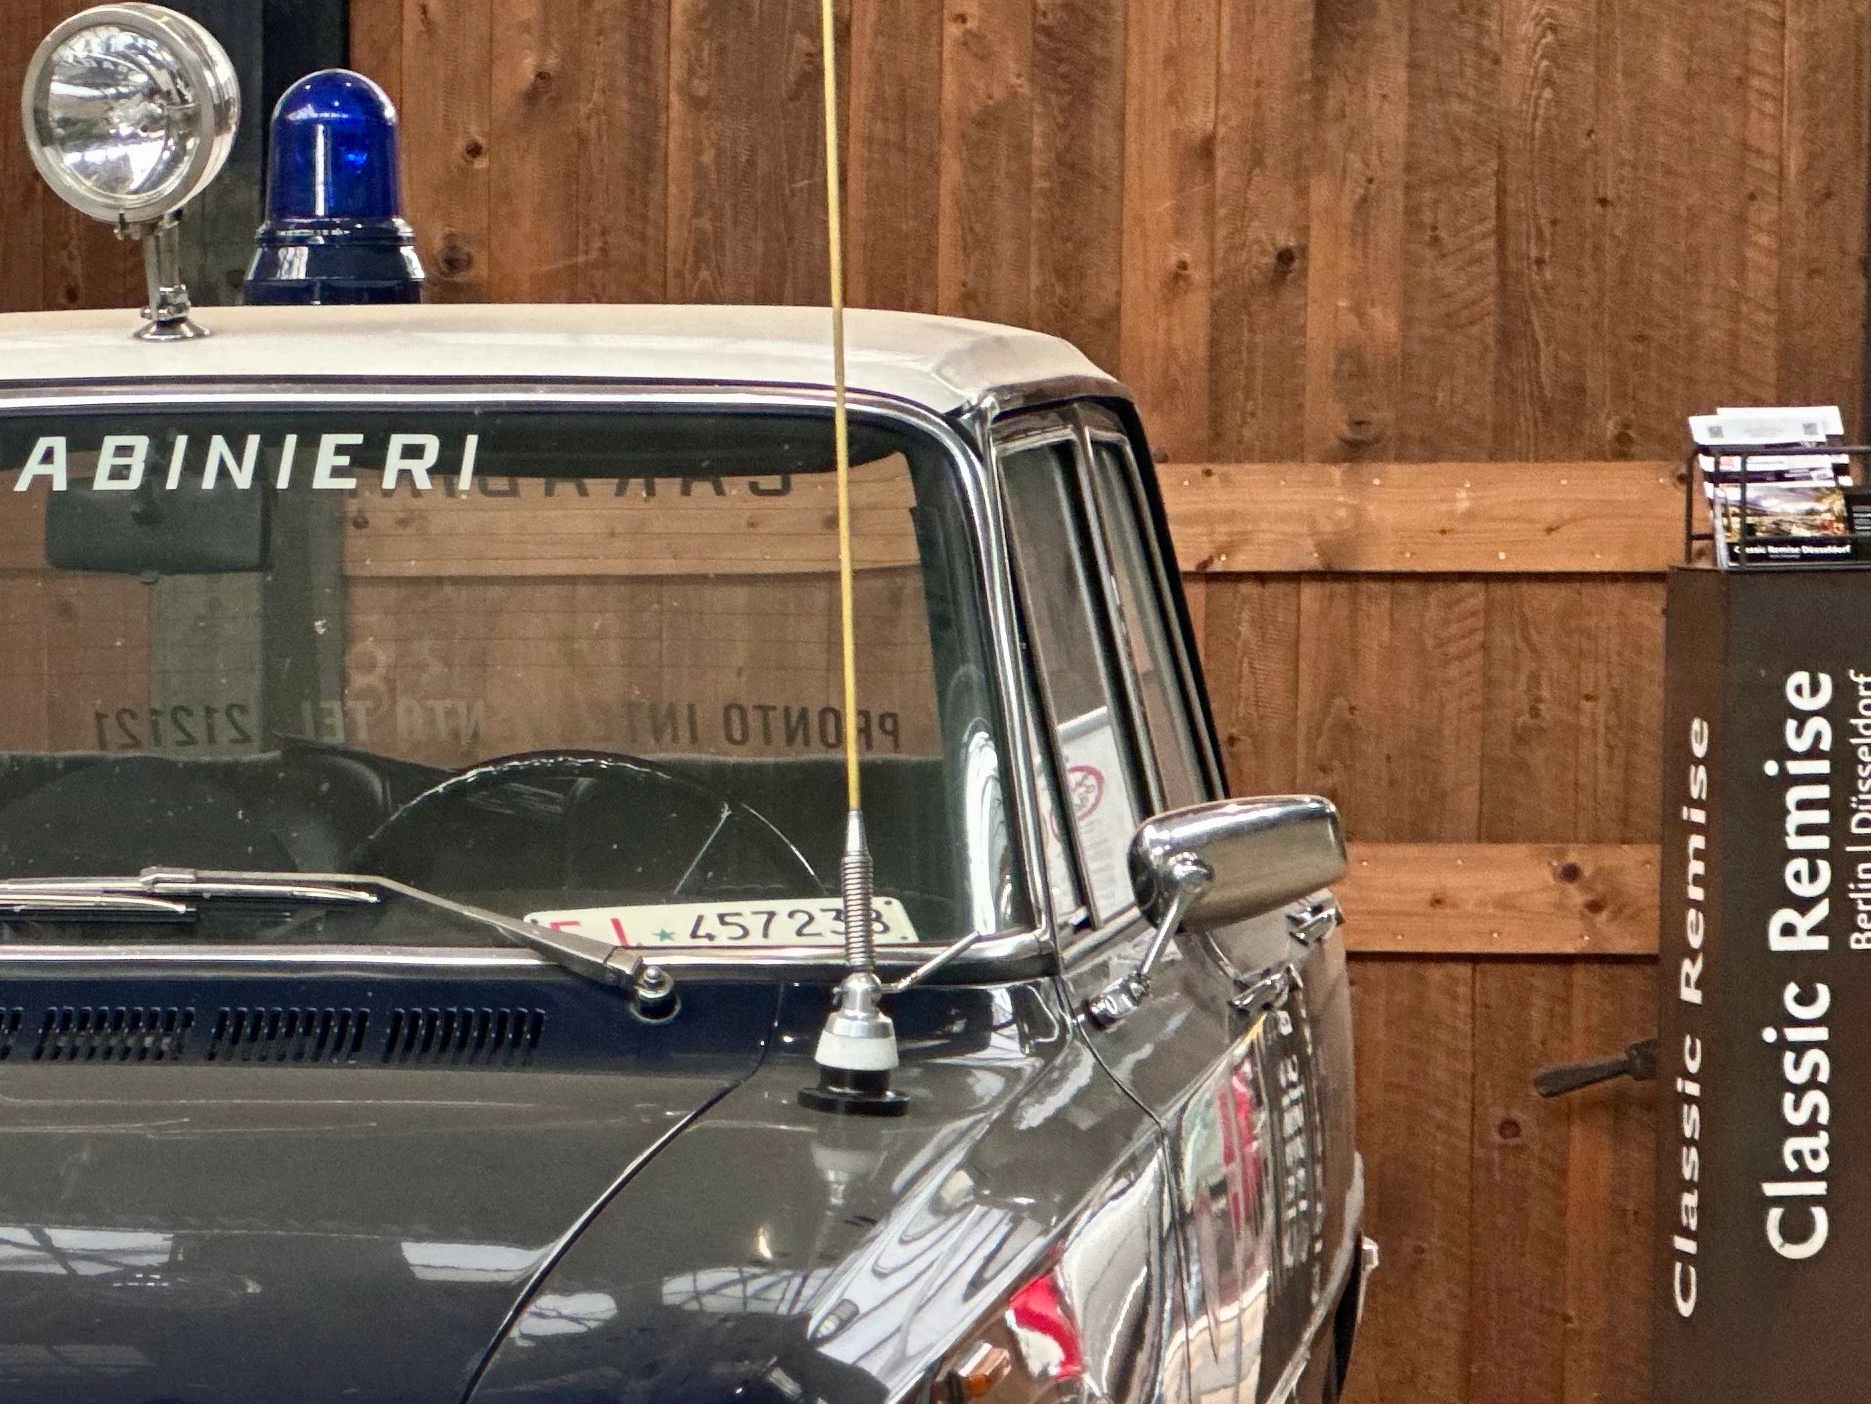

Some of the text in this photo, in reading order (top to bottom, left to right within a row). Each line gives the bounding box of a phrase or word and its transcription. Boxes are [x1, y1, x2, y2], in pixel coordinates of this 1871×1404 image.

[1672, 716, 1709, 1318] Classic Remise
[1761, 670, 1833, 1260] Classic Remise
[1848, 861, 1871, 950] Berlin
